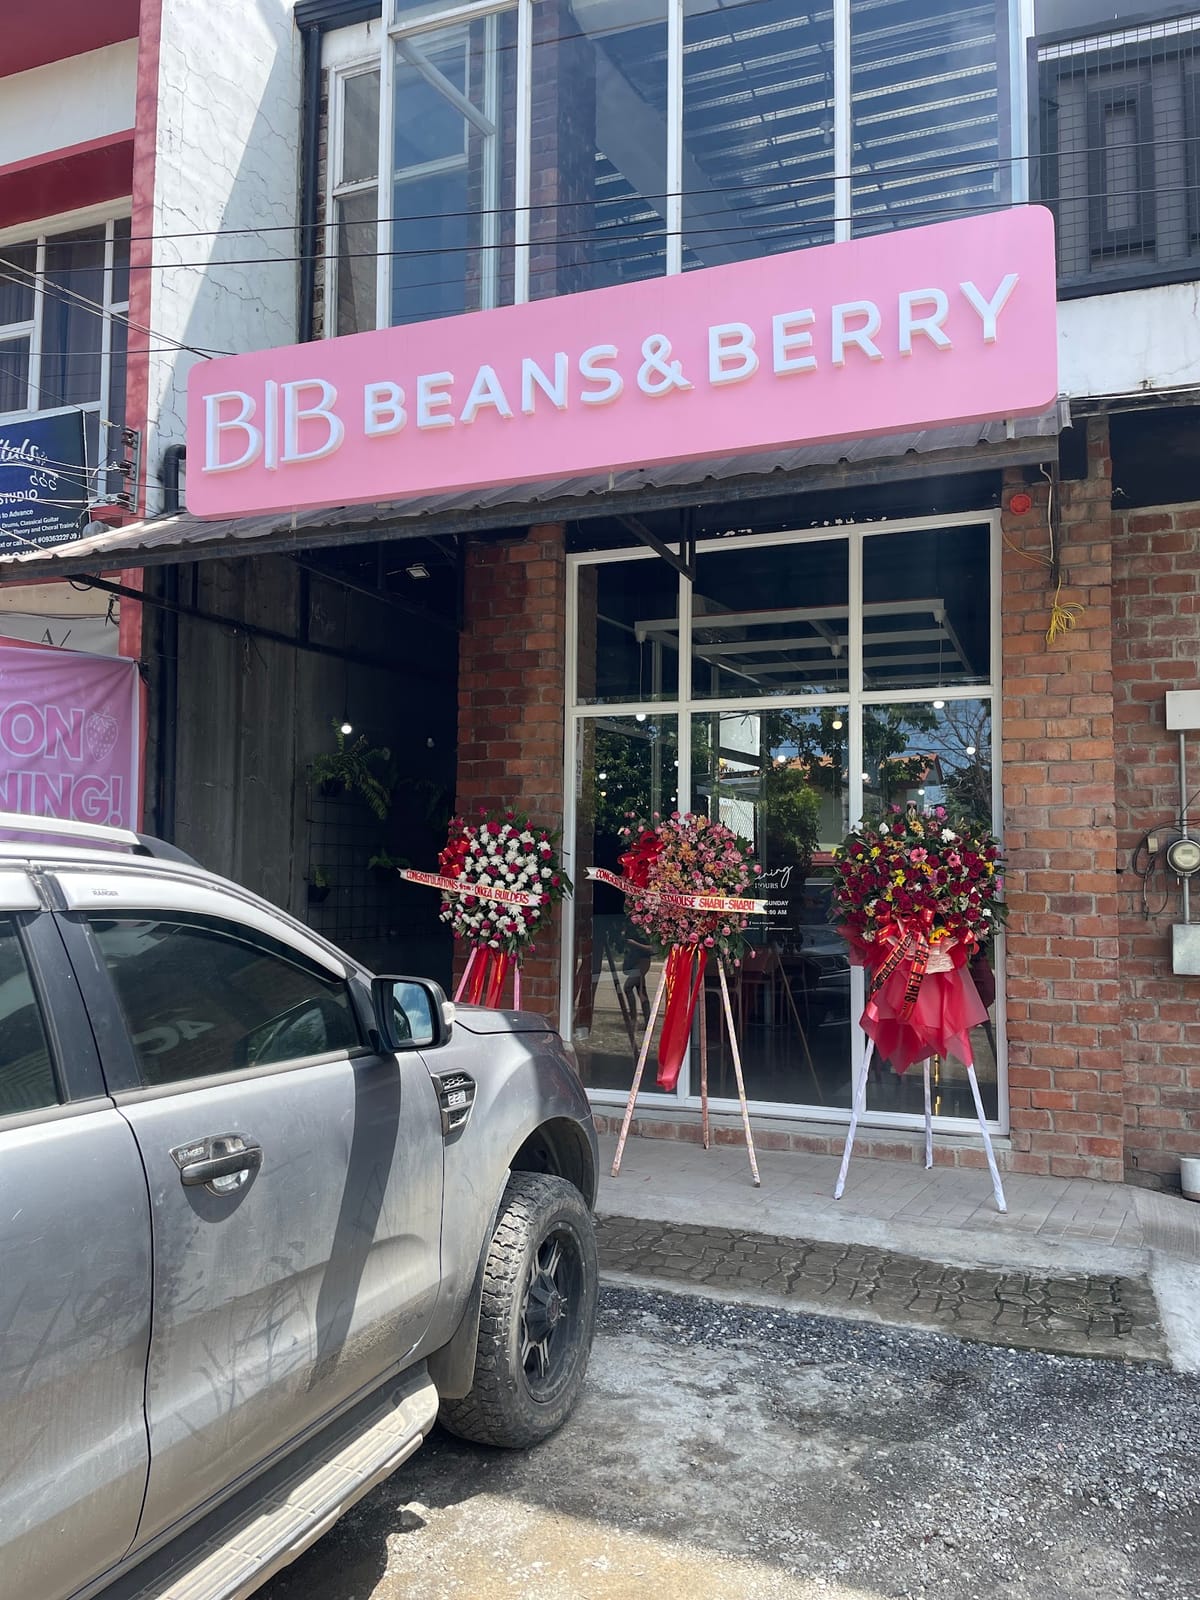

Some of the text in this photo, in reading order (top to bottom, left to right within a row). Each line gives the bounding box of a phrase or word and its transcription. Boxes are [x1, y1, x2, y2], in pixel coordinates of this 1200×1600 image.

[364, 344, 623, 437] BEANS
[637, 334, 695, 398] &
[708, 273, 1020, 387] BERRY
[20, 518, 42, 526] Classical
[0, 701, 85, 762] ON
[495, 889, 529, 904] BUILDERS
[698, 897, 754, 911] SHABU-SHABU
